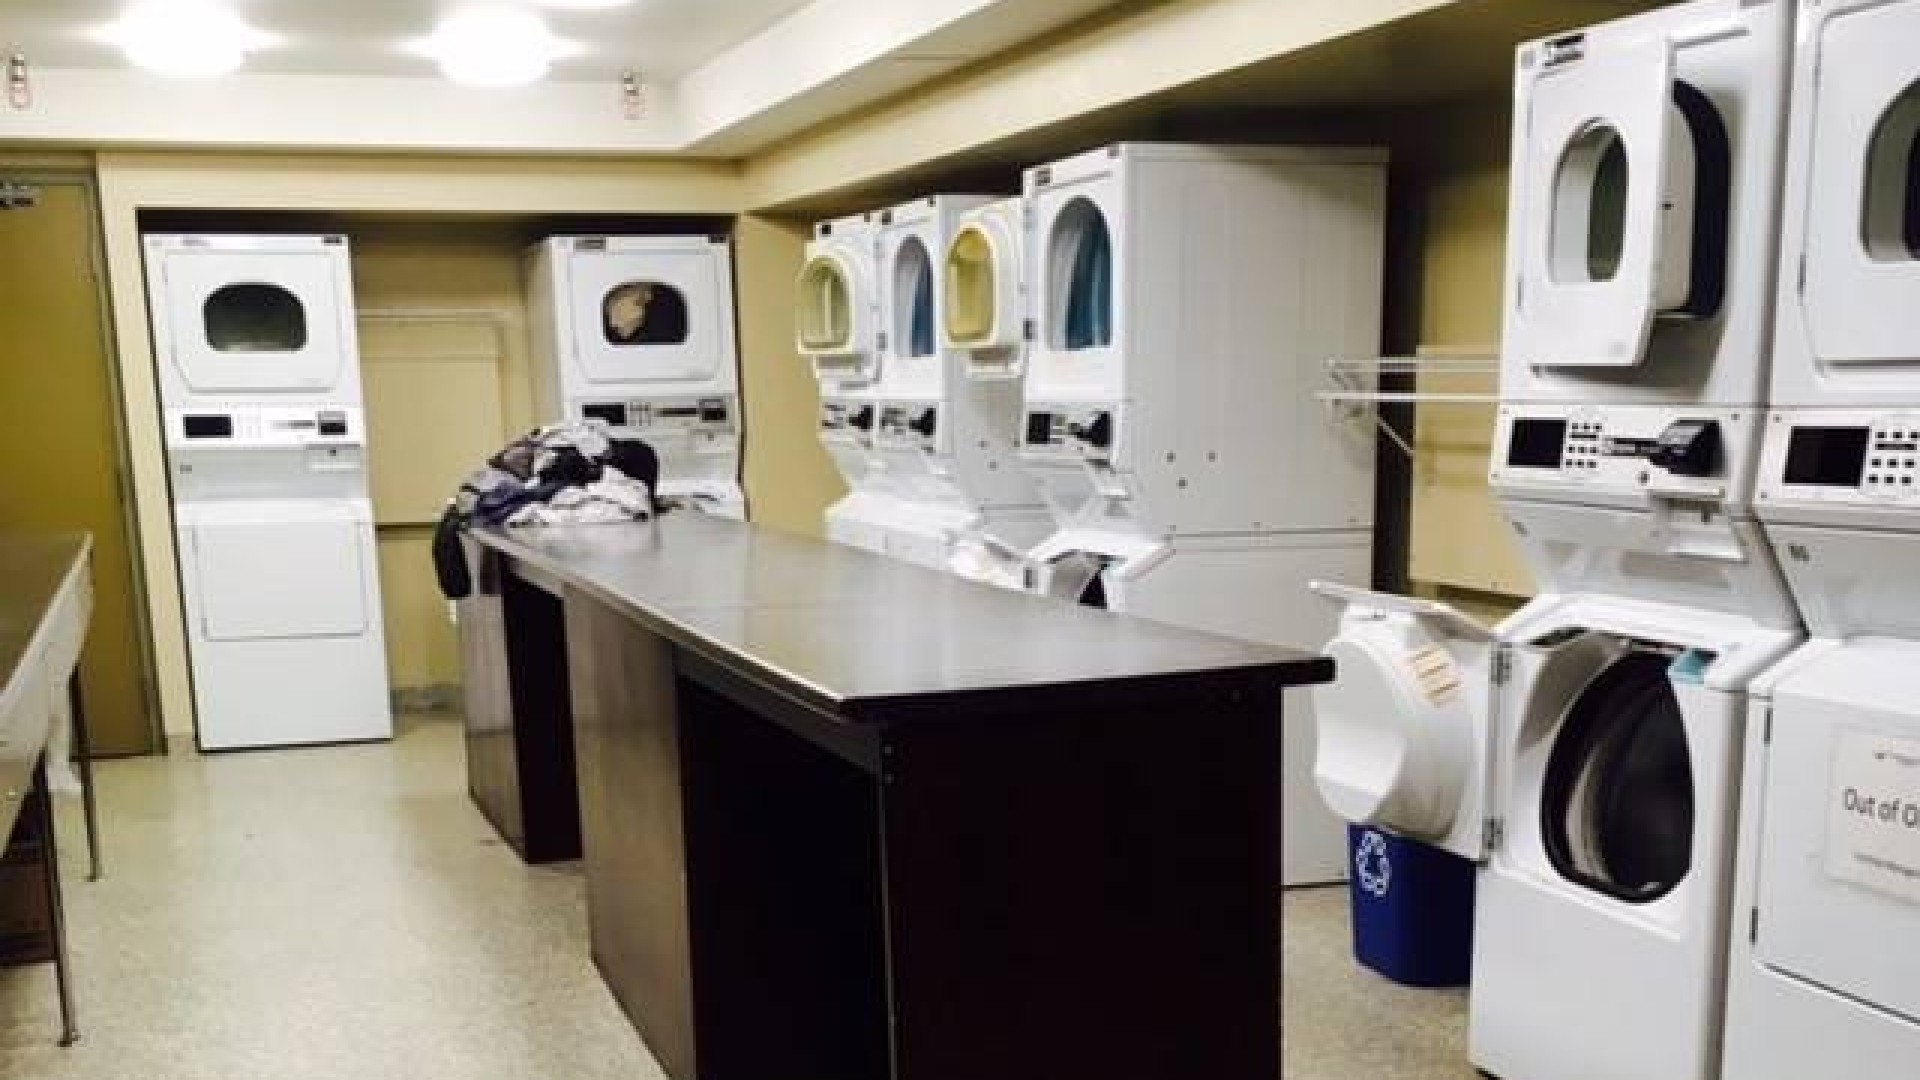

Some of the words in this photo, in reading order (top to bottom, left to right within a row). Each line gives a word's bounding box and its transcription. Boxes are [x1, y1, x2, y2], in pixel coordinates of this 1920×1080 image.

[1844, 788, 1875, 818] Out
[1878, 798, 1900, 822] of
[1902, 803, 1920, 829] O
